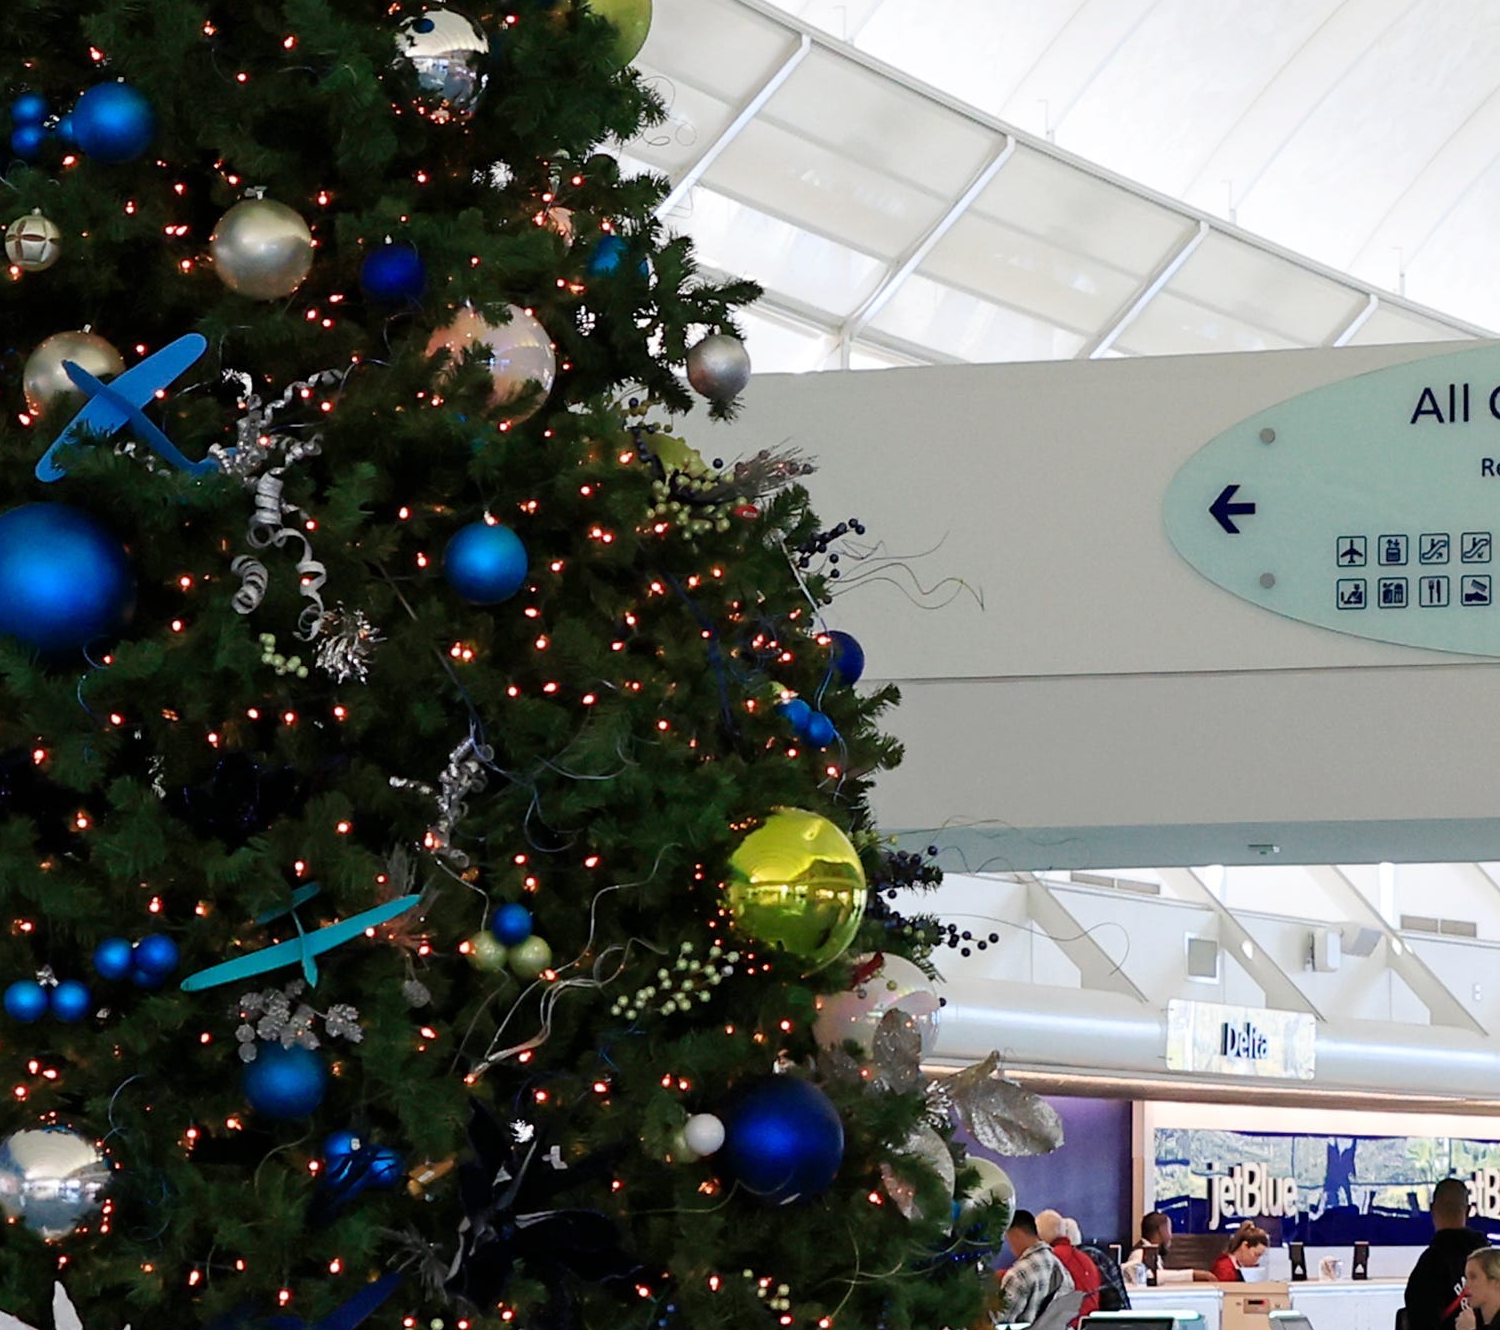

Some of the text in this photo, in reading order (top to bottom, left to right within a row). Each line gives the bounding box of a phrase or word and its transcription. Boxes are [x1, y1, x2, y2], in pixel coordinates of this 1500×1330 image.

[1409, 383, 1470, 425] All
[1219, 1021, 1269, 1060] Delta
[1207, 1161, 1299, 1231] jetBlue
